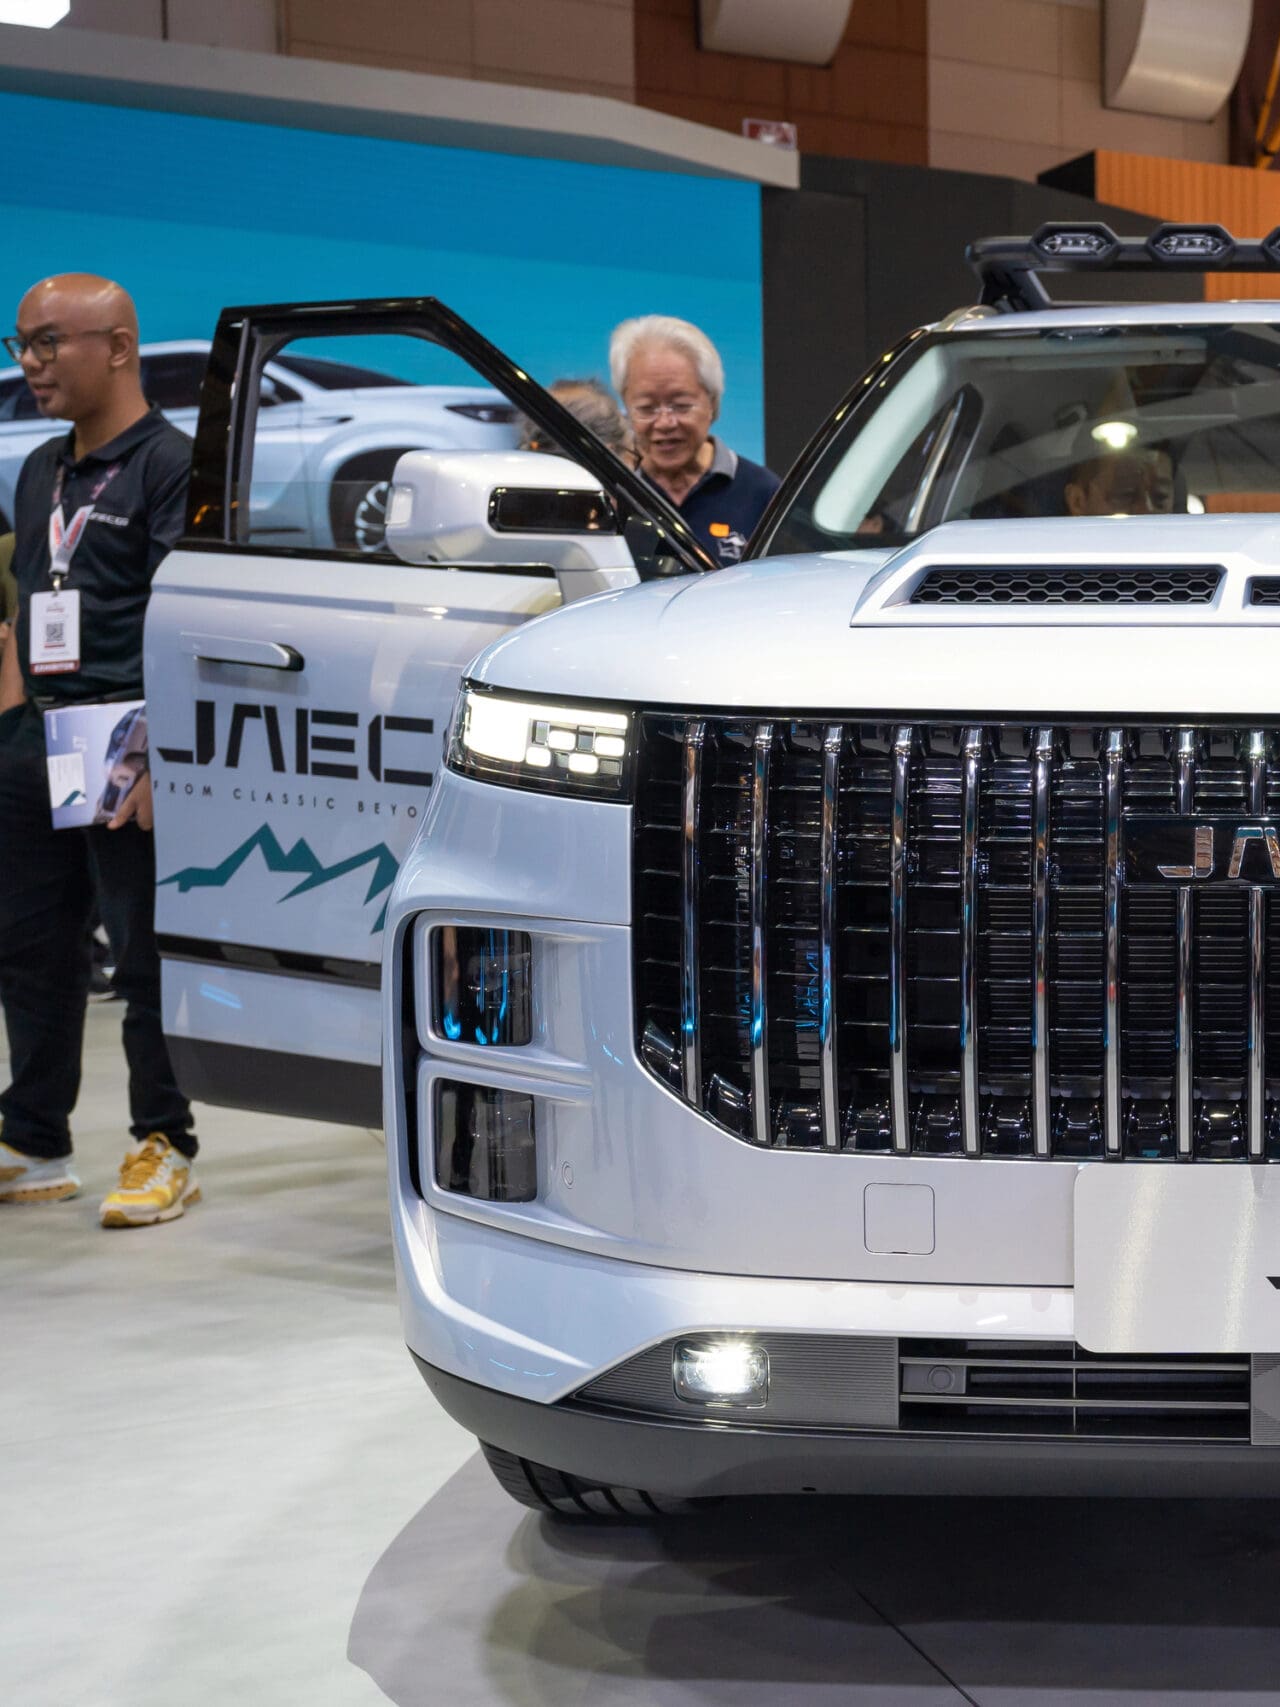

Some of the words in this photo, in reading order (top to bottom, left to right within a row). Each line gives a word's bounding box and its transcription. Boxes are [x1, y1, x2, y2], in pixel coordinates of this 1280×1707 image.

[153, 780, 213, 797] FROM
[232, 788, 335, 810] CLASSIC
[357, 801, 418, 818] BEYO
